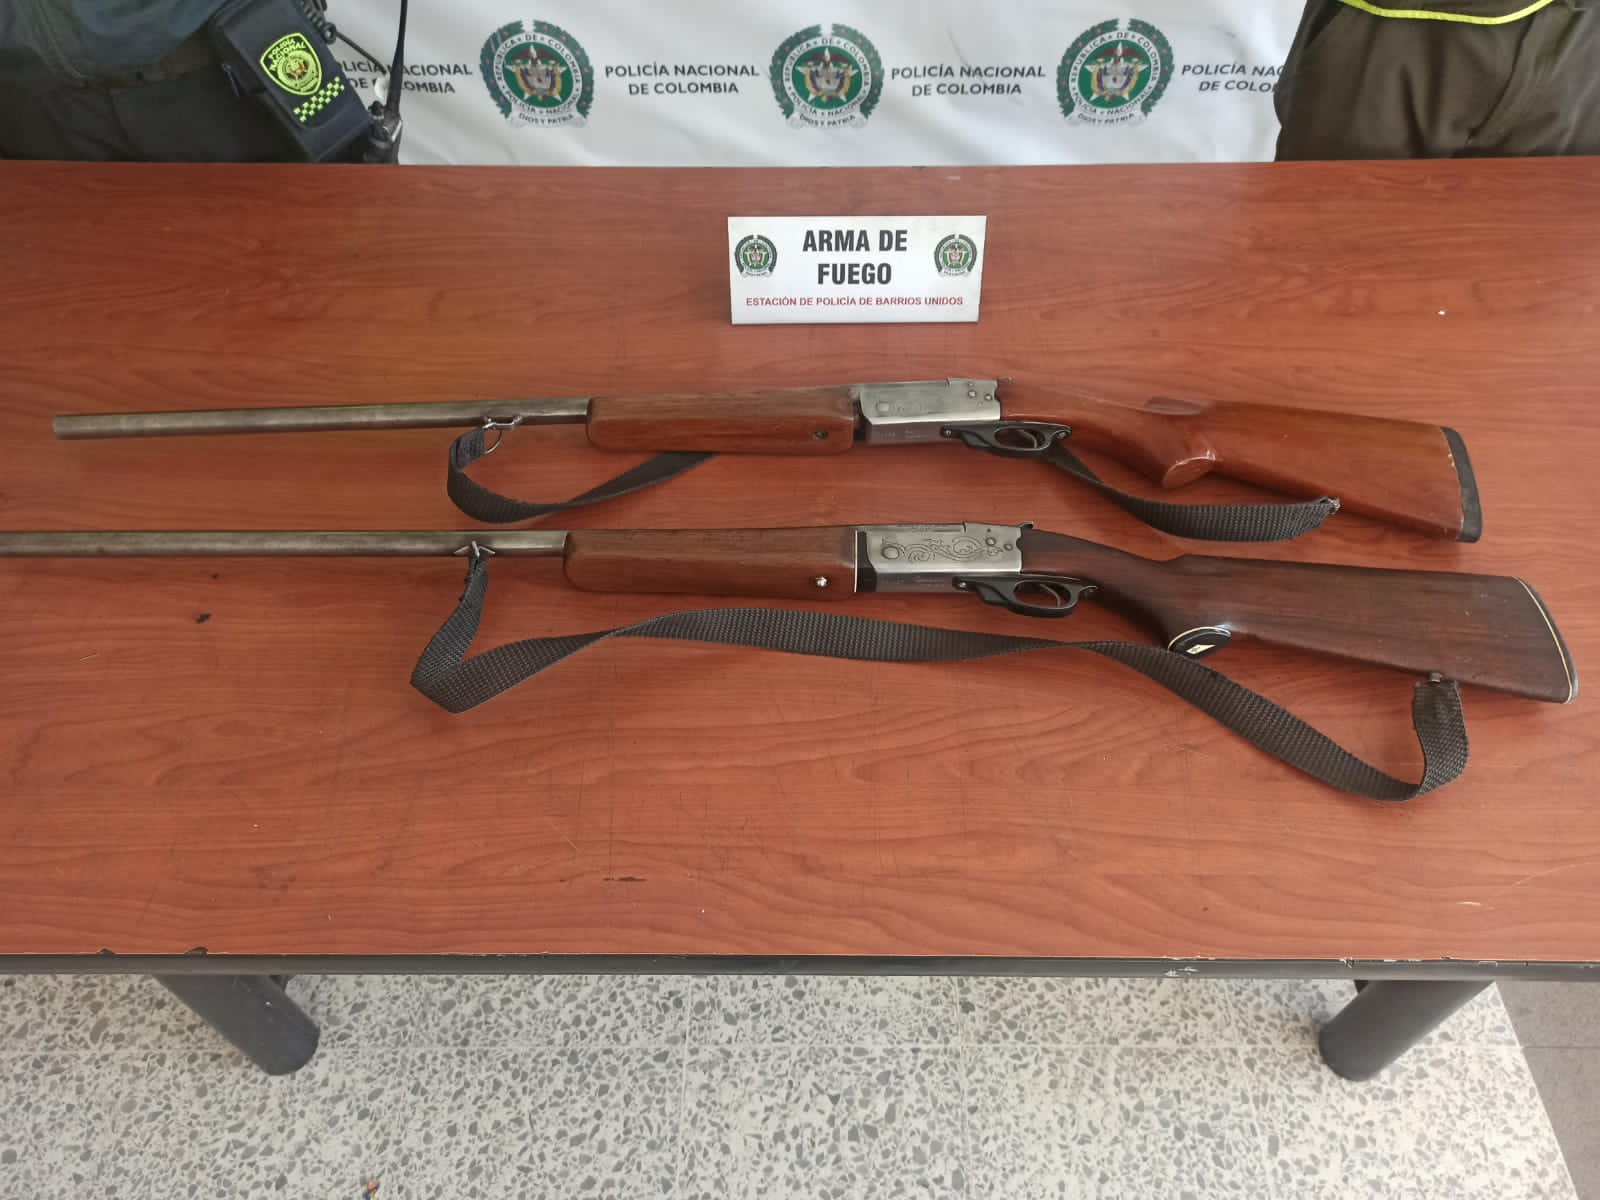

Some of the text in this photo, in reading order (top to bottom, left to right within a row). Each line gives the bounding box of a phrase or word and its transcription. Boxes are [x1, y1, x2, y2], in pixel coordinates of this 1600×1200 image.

[605, 62, 760, 78] POLICÍA NACIONAL
[892, 64, 1046, 80] POLICÍA NACIONAL
[1181, 62, 1247, 76] POLICÍA
[628, 81, 739, 95] DE COLOMBIA
[912, 82, 1022, 97] DE COLOMBIA
[1199, 80, 1276, 93] DE COLO
[802, 229, 908, 252] ARMA DE
[817, 263, 892, 285] FUEGO
[746, 296, 964, 306] ESTACIÓN DE POLICÍA DE BARRIOS UNIDOS
